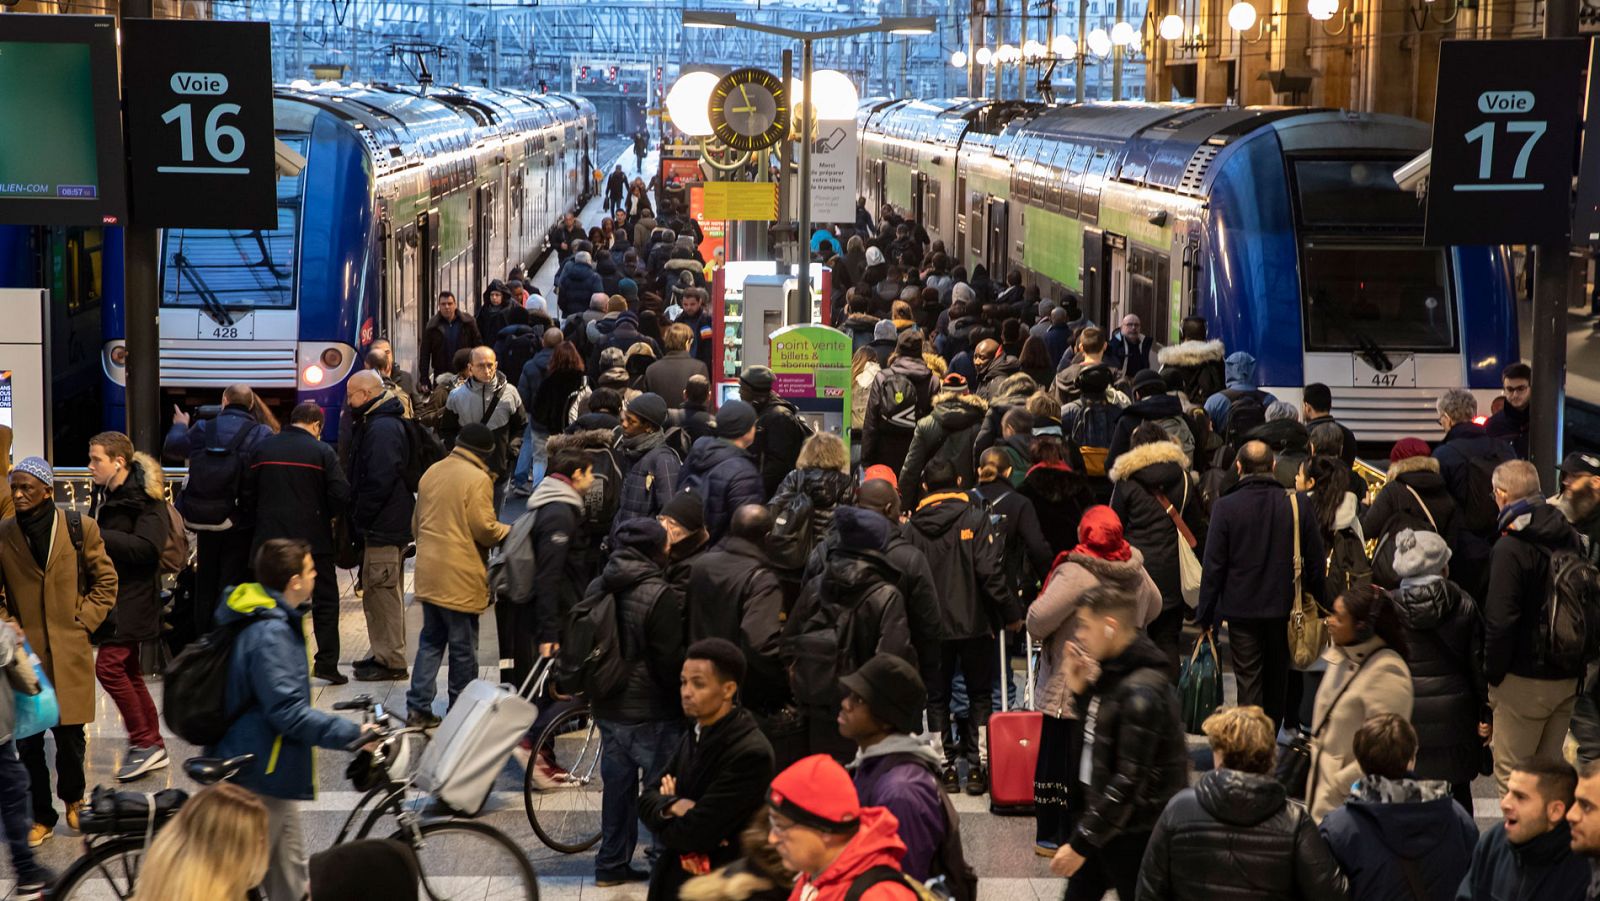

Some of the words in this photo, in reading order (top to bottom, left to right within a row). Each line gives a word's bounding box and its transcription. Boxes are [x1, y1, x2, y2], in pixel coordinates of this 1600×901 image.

[177, 75, 220, 92] Voie
[1485, 93, 1527, 110] Voie
[160, 102, 246, 163] 16
[1463, 120, 1548, 179] 17
[212, 327, 238, 338] 428
[776, 340, 808, 352] point
[811, 341, 846, 351] vente
[780, 352, 809, 360] billets
[1371, 373, 1399, 387] 447
